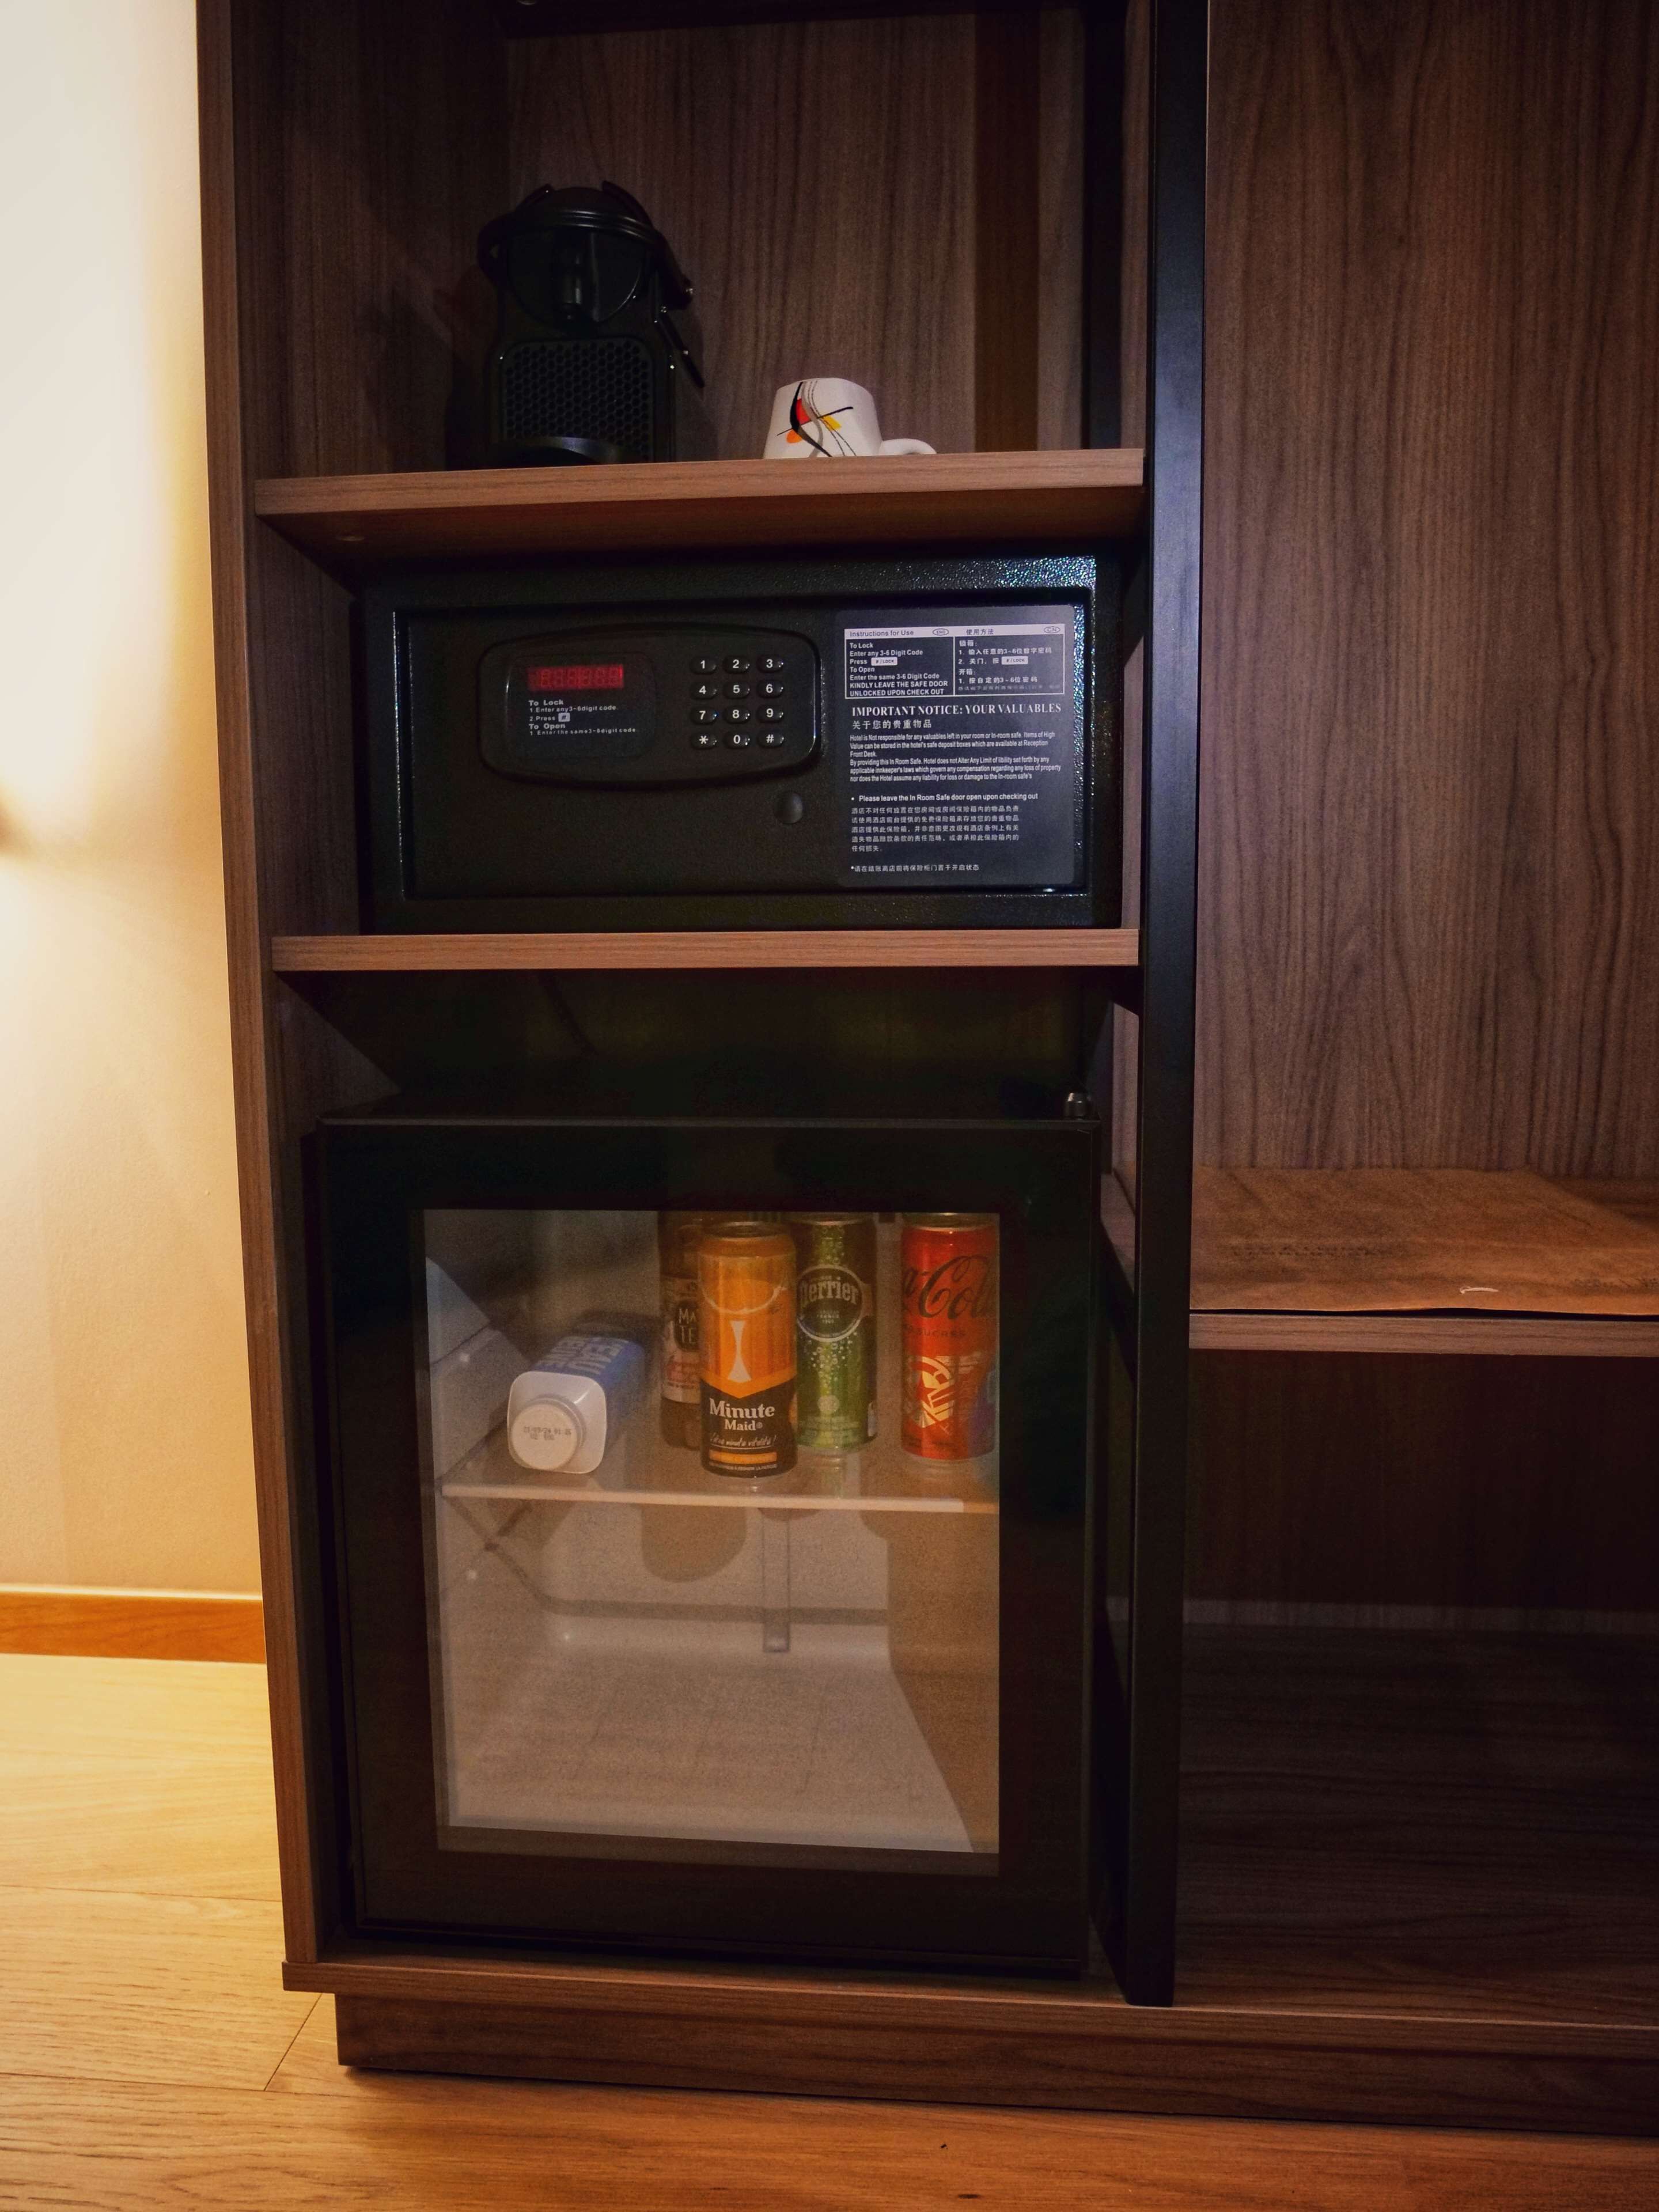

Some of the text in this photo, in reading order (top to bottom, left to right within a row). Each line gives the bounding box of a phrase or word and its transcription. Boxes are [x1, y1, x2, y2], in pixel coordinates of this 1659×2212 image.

[700, 659, 772, 669] 1 2 3
[699, 684, 773, 694] 4 5 6
[699, 708, 774, 719] 7 8 9
[853, 703, 1061, 717] IMPORTANT NOTICE: YOUR VALUABLES
[853, 719, 931, 729] 关于您的贵重物品
[733, 734, 774, 744] 0 #
[1044, 731, 1055, 739] High
[710, 1397, 775, 1418] Minute
